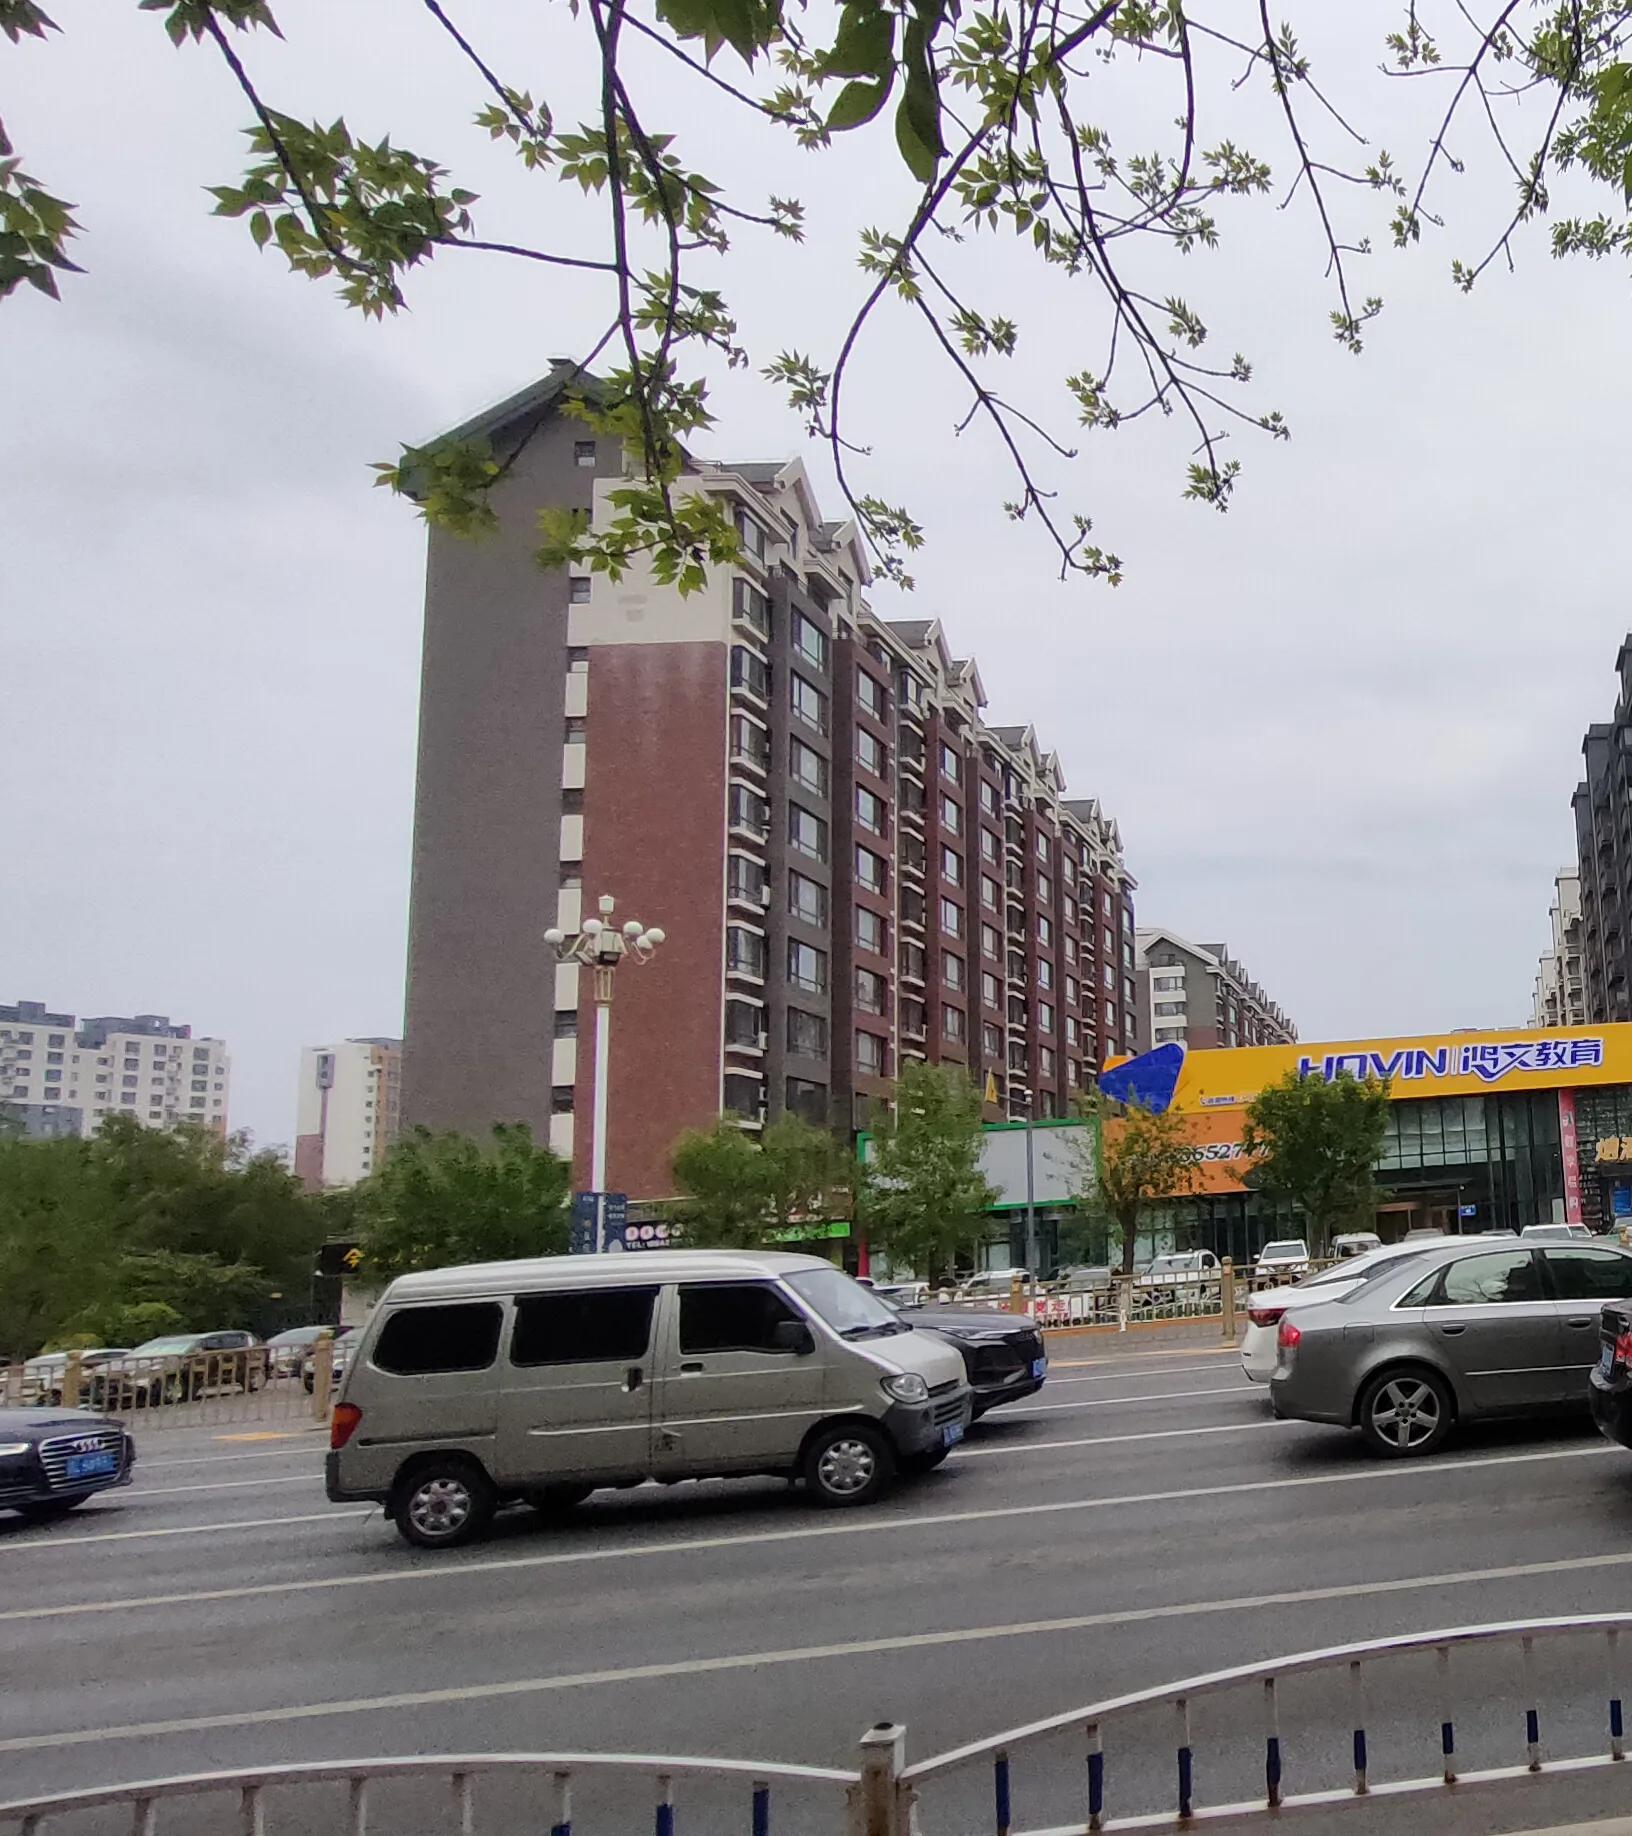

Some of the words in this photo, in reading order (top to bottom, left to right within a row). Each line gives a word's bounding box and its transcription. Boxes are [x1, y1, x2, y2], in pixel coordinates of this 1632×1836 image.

[1299, 1047, 1447, 1084] HOVIN
[1462, 1039, 1602, 1080] 鸿文教育
